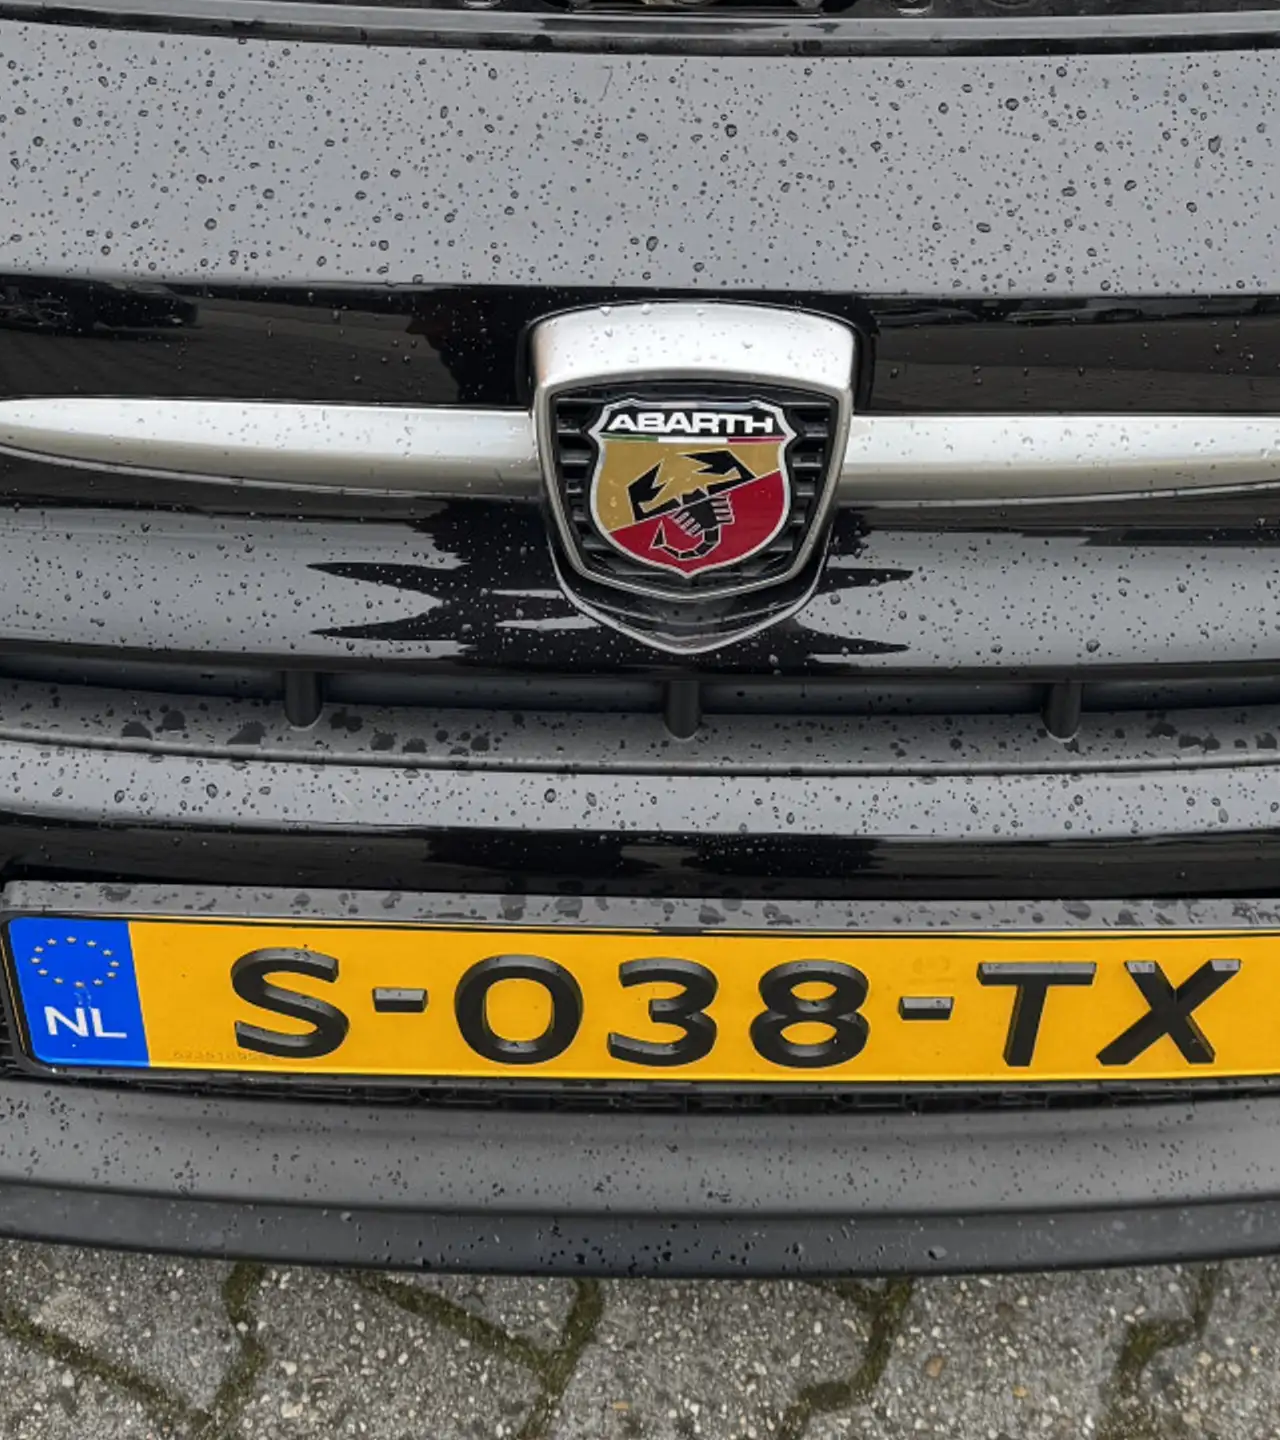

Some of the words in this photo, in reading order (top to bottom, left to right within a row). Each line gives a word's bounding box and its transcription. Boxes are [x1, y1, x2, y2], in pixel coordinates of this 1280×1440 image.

[607, 411, 774, 434] ABARTH
[44, 1006, 128, 1038] NL
[230, 947, 1242, 1066] S-038-TX
